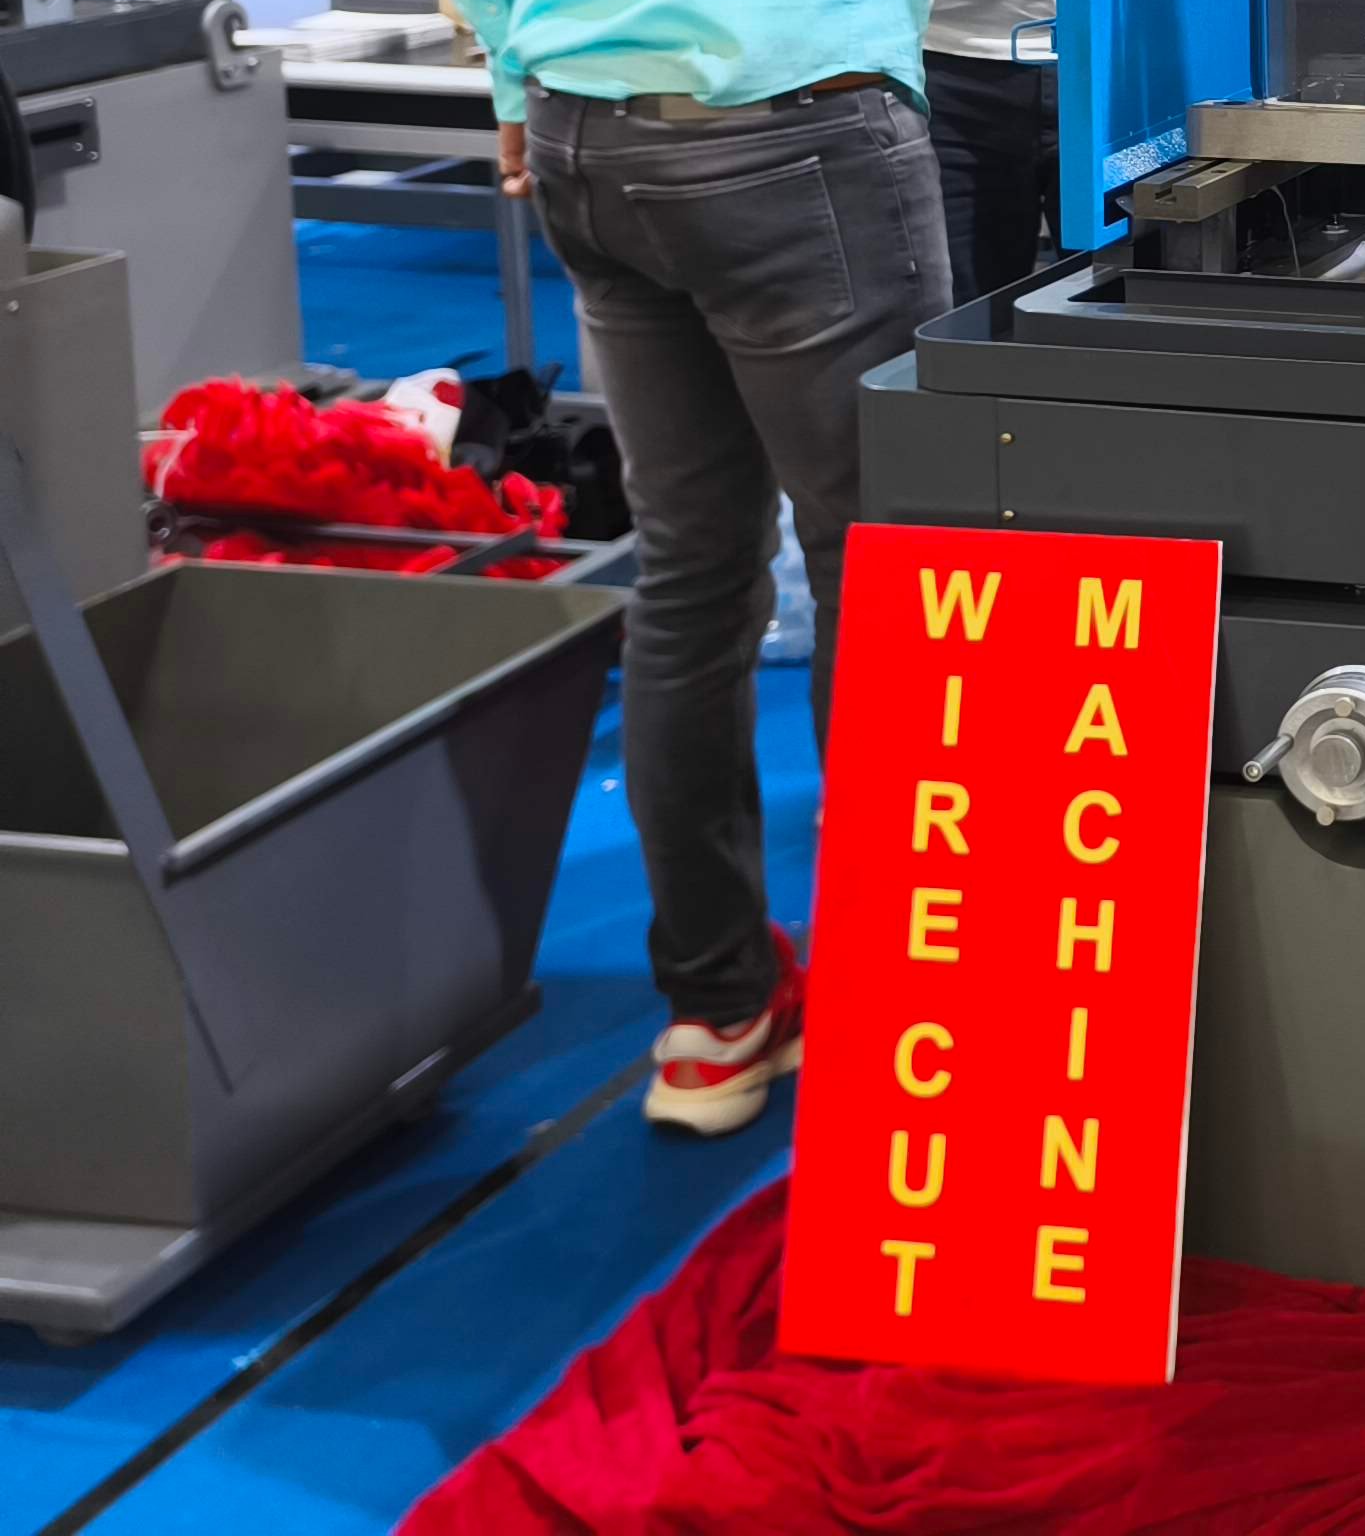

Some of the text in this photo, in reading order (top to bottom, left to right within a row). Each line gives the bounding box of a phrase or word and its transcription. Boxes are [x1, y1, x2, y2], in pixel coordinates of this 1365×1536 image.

[881, 568, 1001, 1316] WIRE CUT
[1032, 577, 1143, 1305] MACHINE
